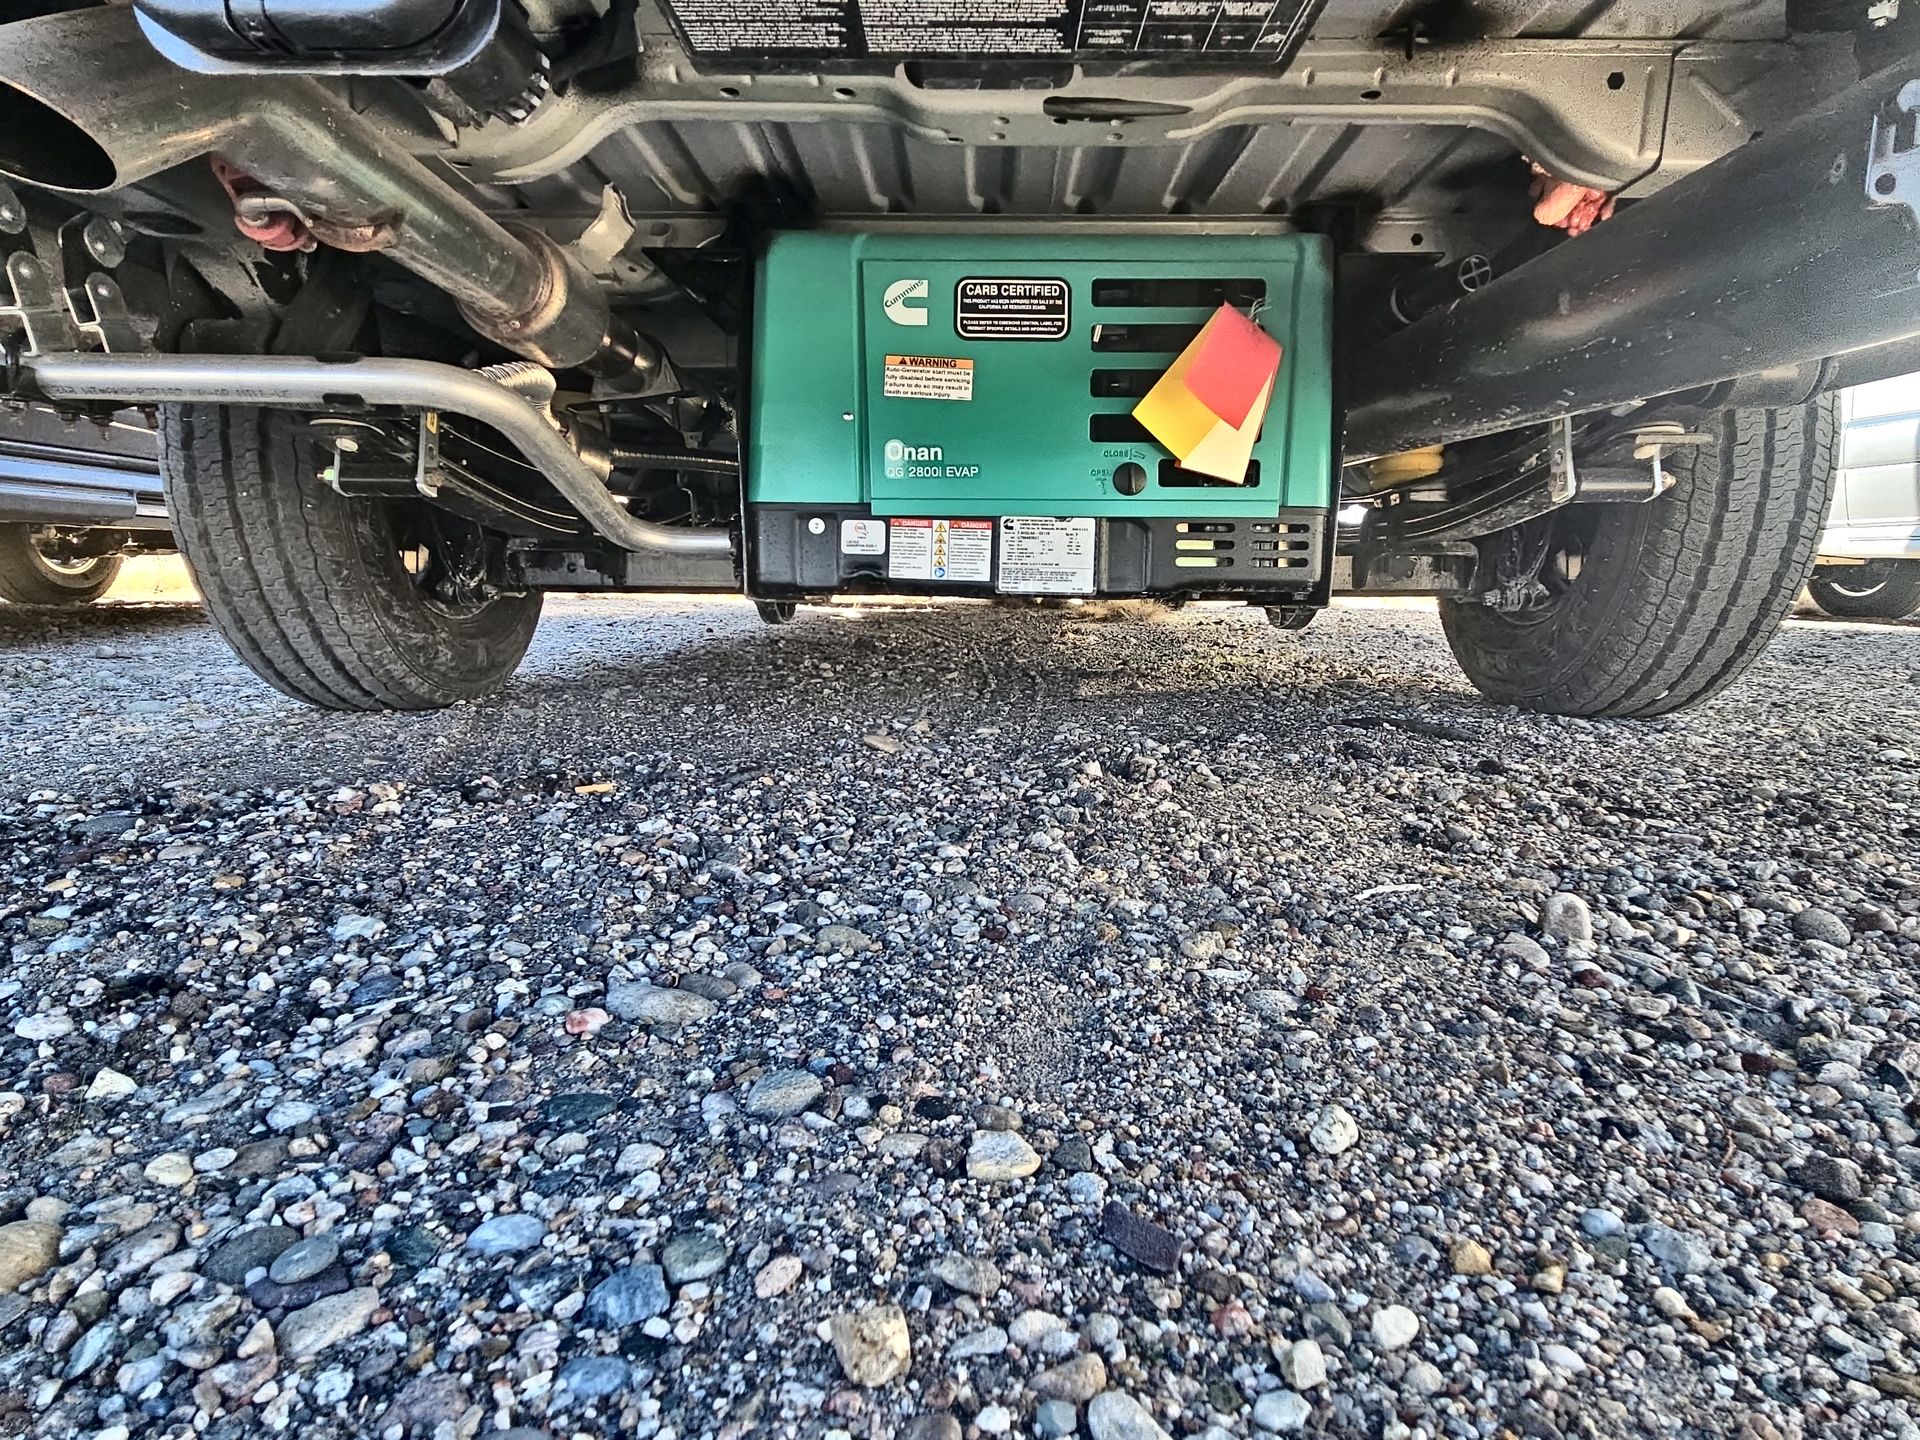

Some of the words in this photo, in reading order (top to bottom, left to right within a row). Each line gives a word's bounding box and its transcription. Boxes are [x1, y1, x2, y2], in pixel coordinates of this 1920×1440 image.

[885, 280, 923, 307] Cummins
[966, 284, 998, 296] CARB
[1001, 285, 1060, 296] CERTIFIED
[909, 357, 957, 368] WARNING
[886, 441, 943, 461] Onan
[946, 466, 979, 478] EVAP
[960, 521, 988, 529] DANGER
